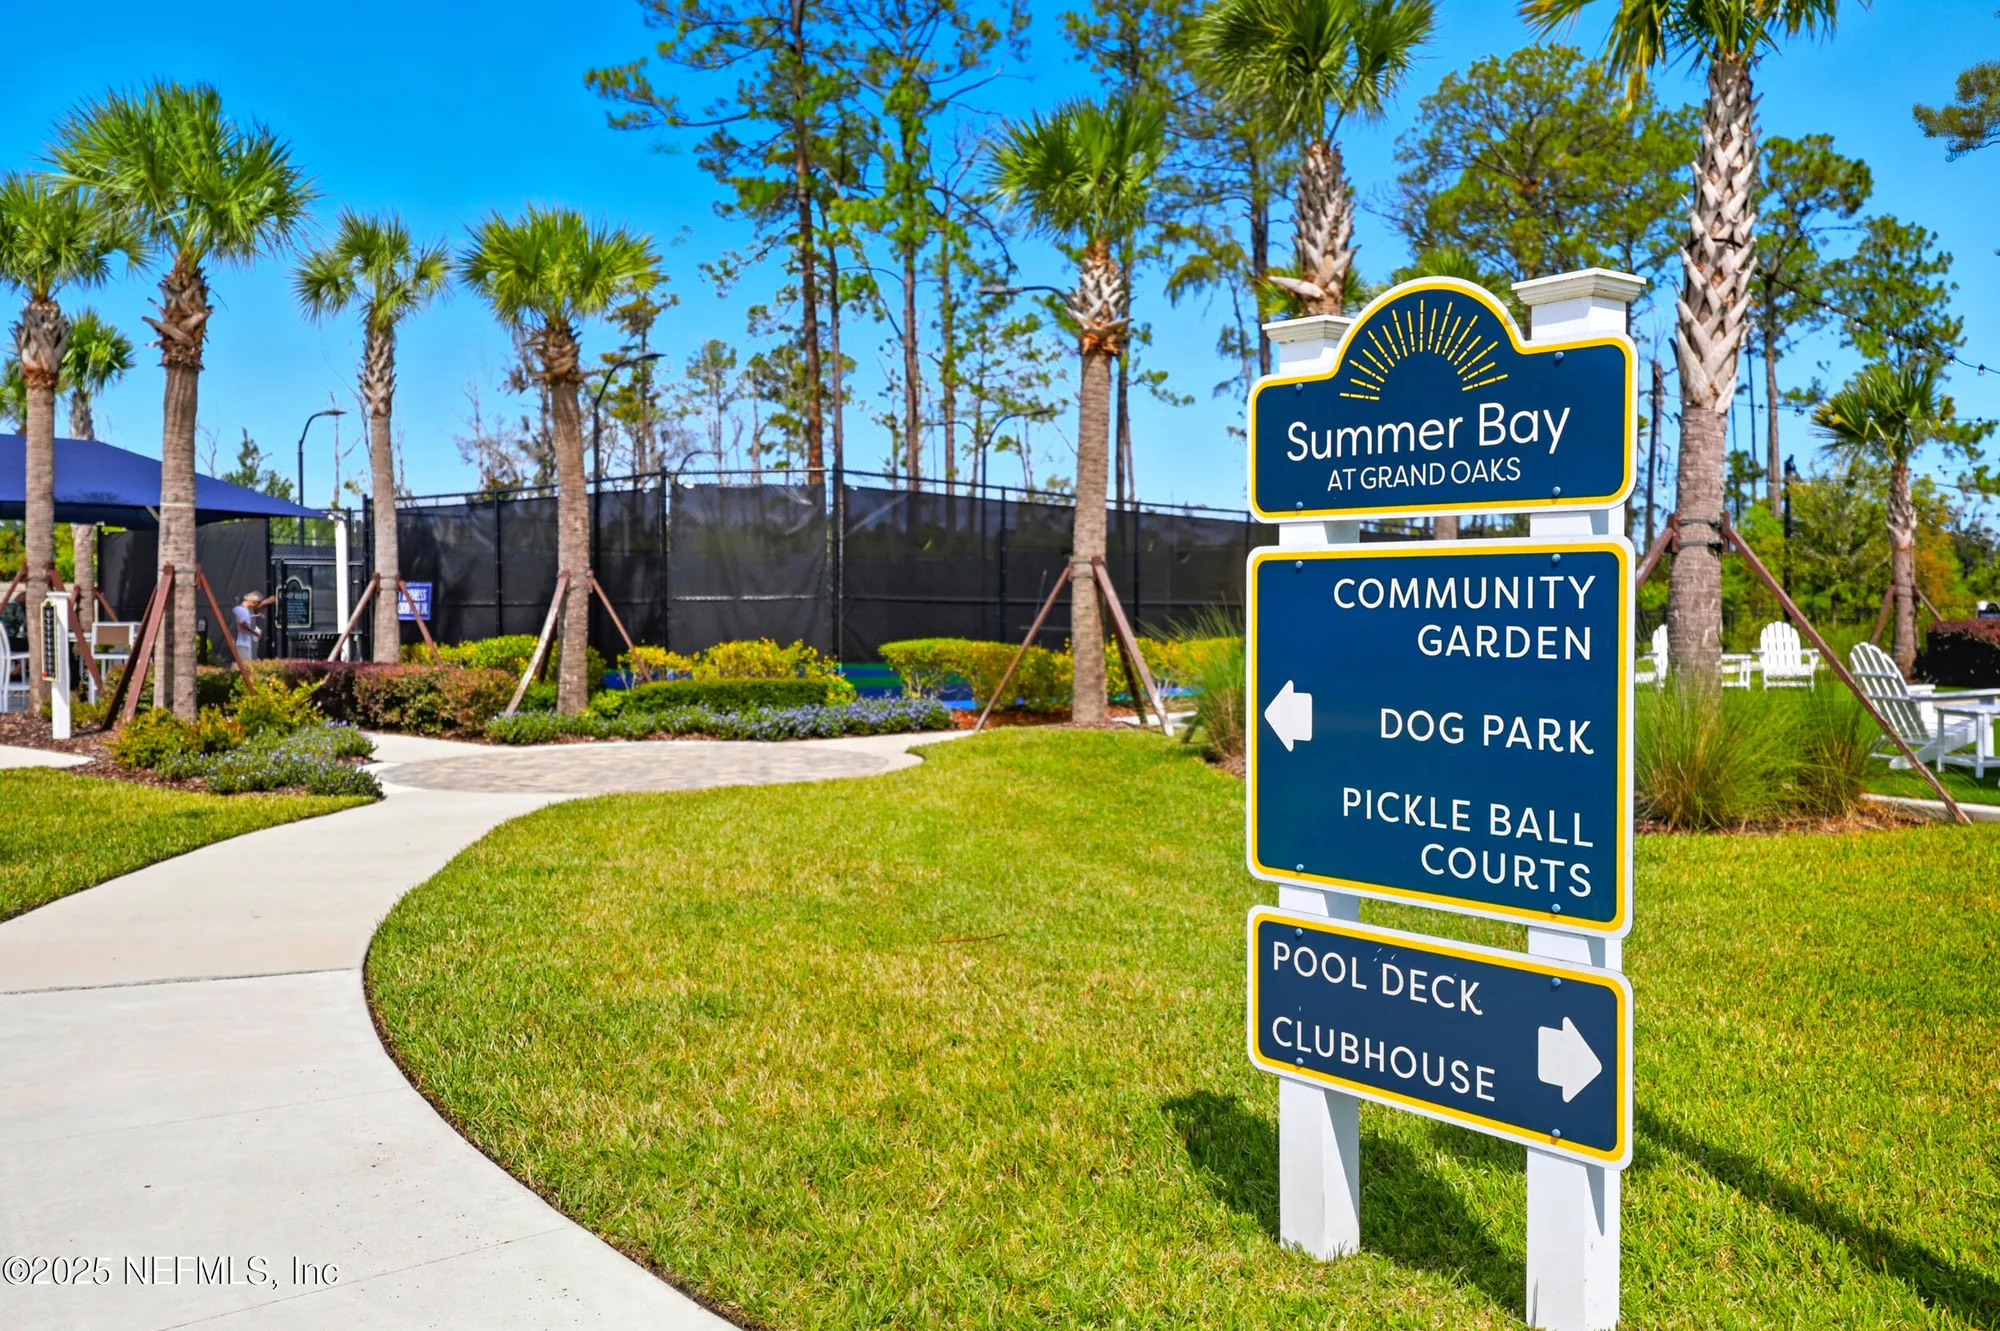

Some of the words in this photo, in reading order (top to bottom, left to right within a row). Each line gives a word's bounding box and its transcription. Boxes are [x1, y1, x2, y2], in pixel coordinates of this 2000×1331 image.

[1287, 416, 1464, 462] Summer
[1479, 402, 1571, 455] Bay
[1327, 468, 1357, 492] AT
[1360, 462, 1446, 490] GRAND
[1450, 457, 1521, 484] OAKS
[1333, 575, 1596, 610] COMMUNITY
[1417, 624, 1591, 661] GARDEN
[1380, 708, 1464, 744] DOG
[1483, 714, 1595, 755] PARK
[1343, 787, 1471, 832] PICKLE
[1490, 803, 1593, 848] BALL
[1421, 843, 1592, 898] COURTS
[1273, 941, 1367, 990] POOL
[1382, 963, 1483, 1016] DECK
[1272, 1016, 1495, 1102] CLUBHOUSE
